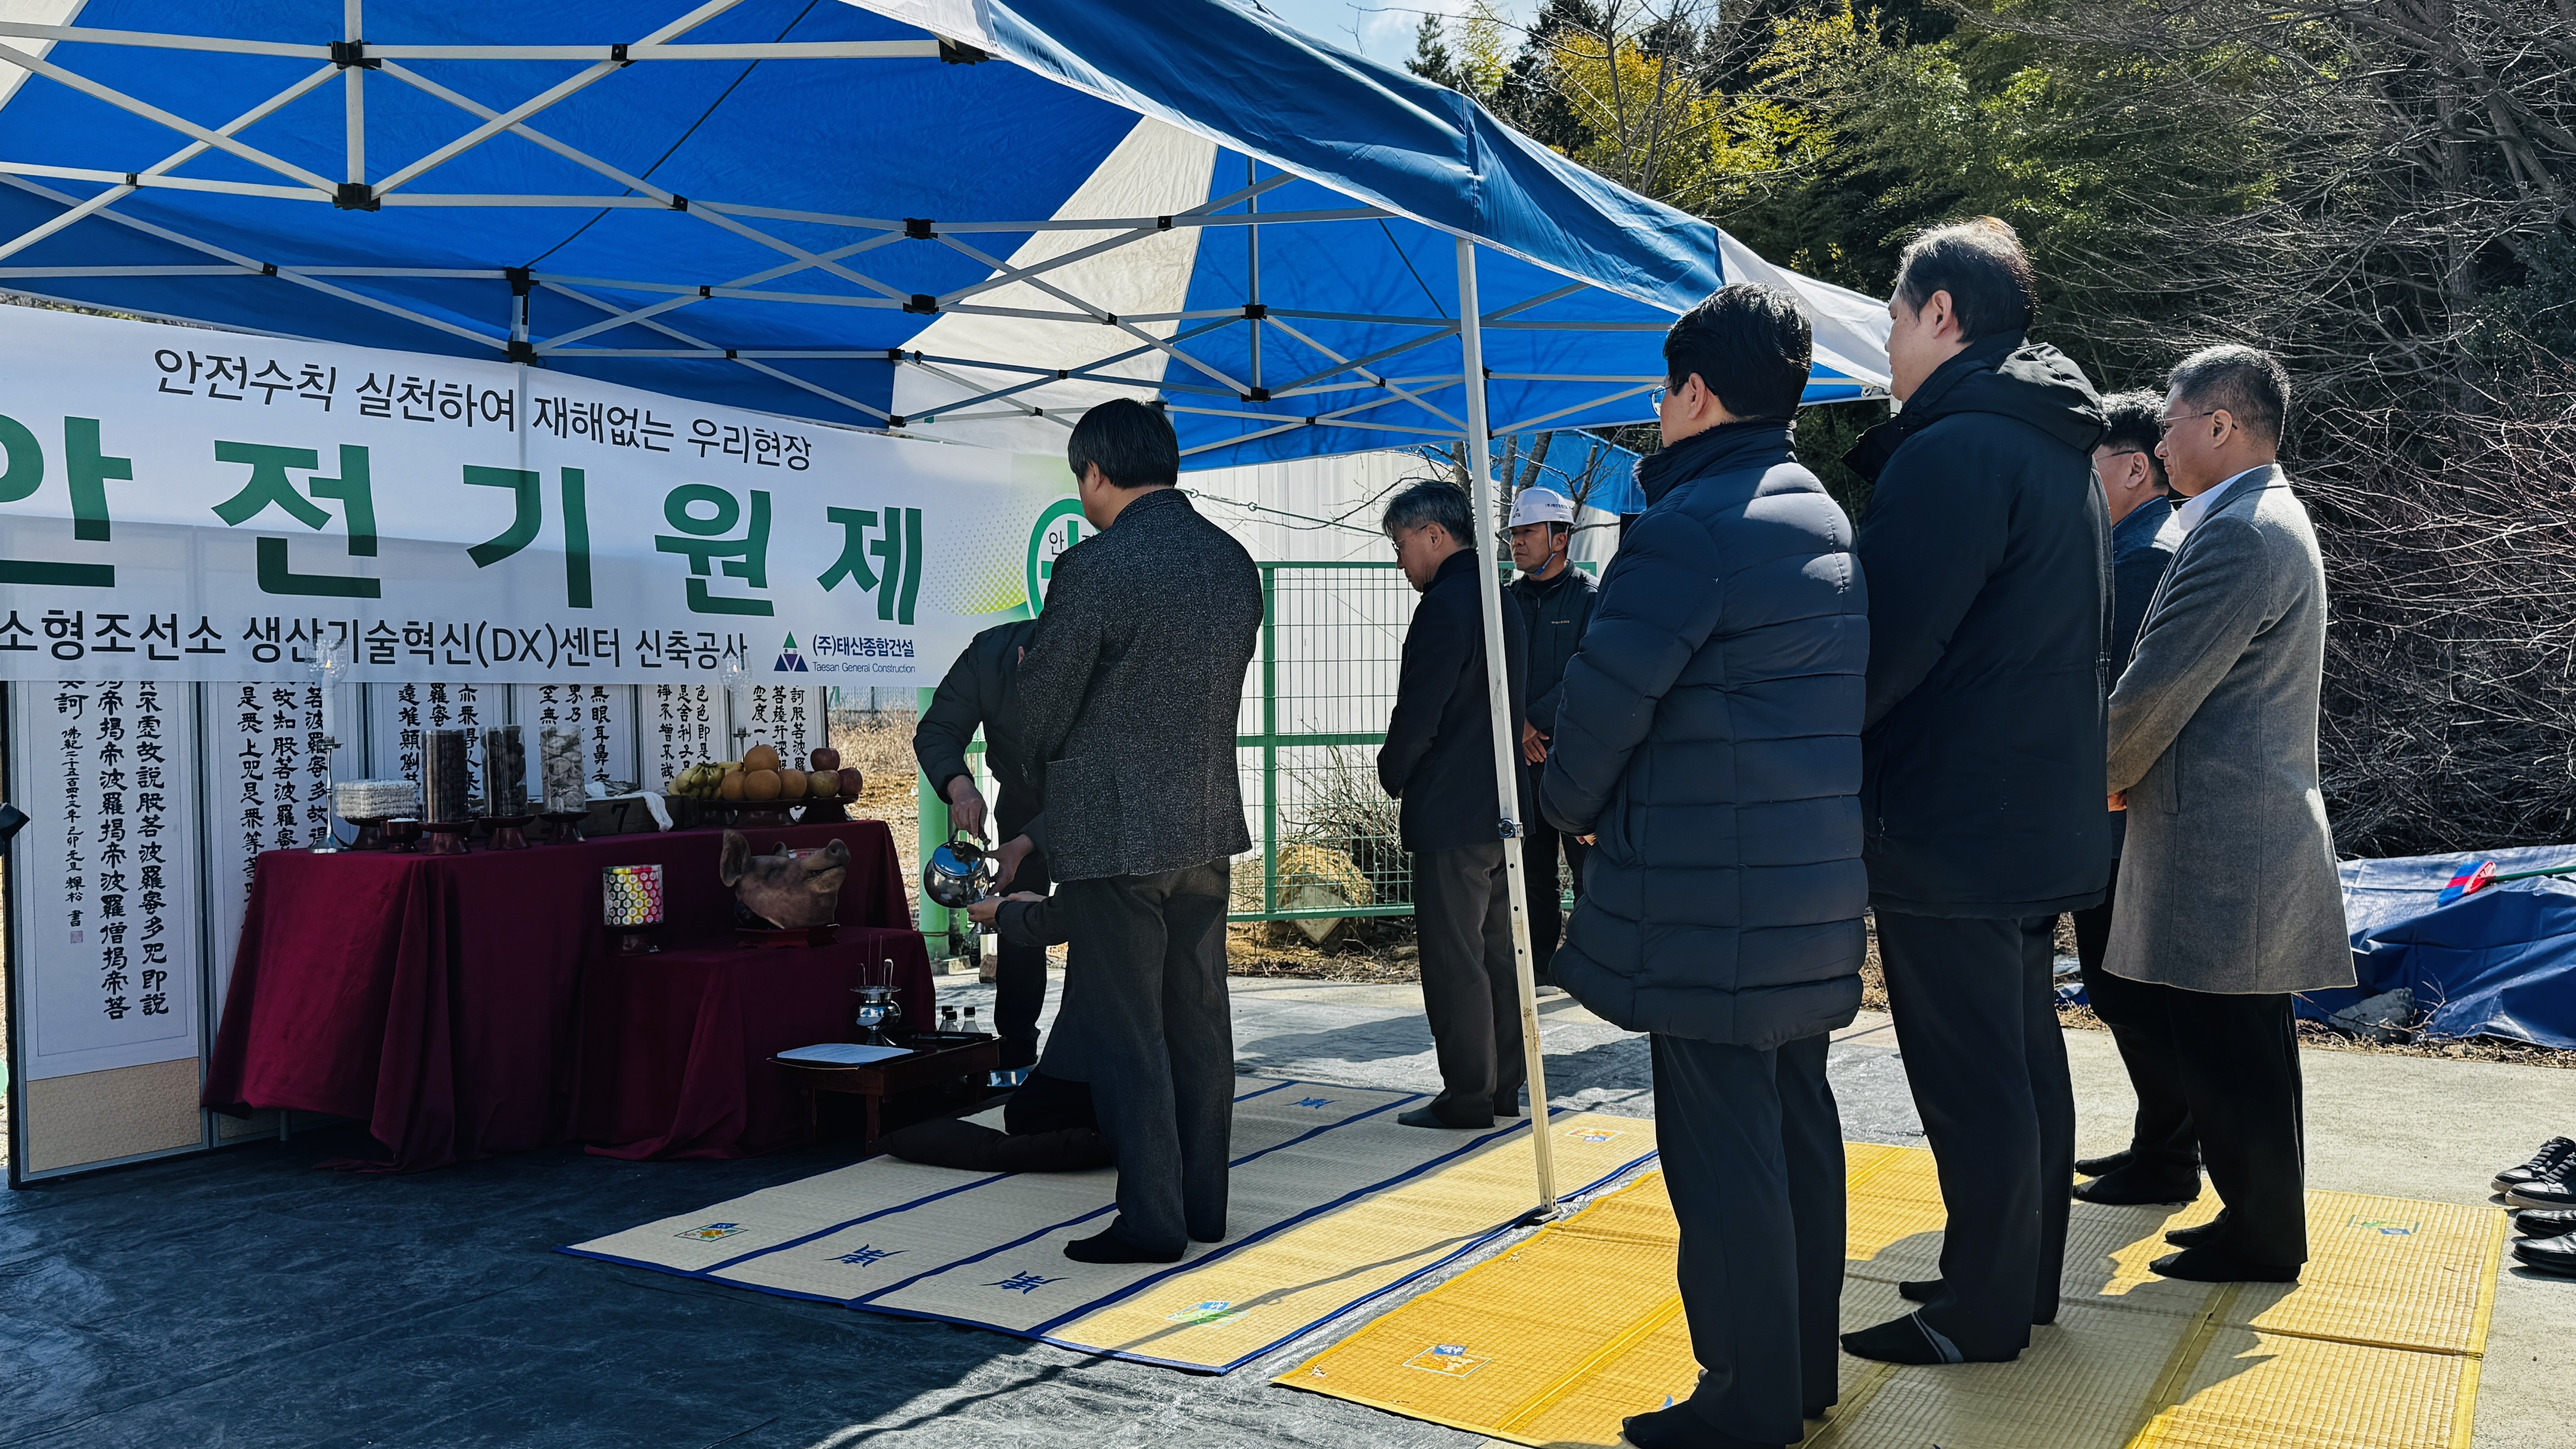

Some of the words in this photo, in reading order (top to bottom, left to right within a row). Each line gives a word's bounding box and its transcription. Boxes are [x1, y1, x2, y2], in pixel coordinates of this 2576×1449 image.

[154, 349, 337, 411] 안전수칙
[356, 372, 515, 432] 실천하여
[533, 395, 675, 451] 재해없는
[687, 417, 812, 471] 우리현장
[0, 413, 922, 625] 안전기원제
[0, 610, 226, 662] 소형조선소
[242, 617, 621, 669] 생산기술혁신(DX)센터
[635, 629, 748, 668] 신축공사
[812, 662, 839, 672] Taesan
[842, 662, 870, 672] General
[872, 663, 915, 673] Construction
[813, 634, 915, 657] (주)태산종합건설
[696, 685, 711, 764] 色色即是
[752, 685, 768, 745] 空度一
[271, 682, 300, 850] 故知般若波羅蜜
